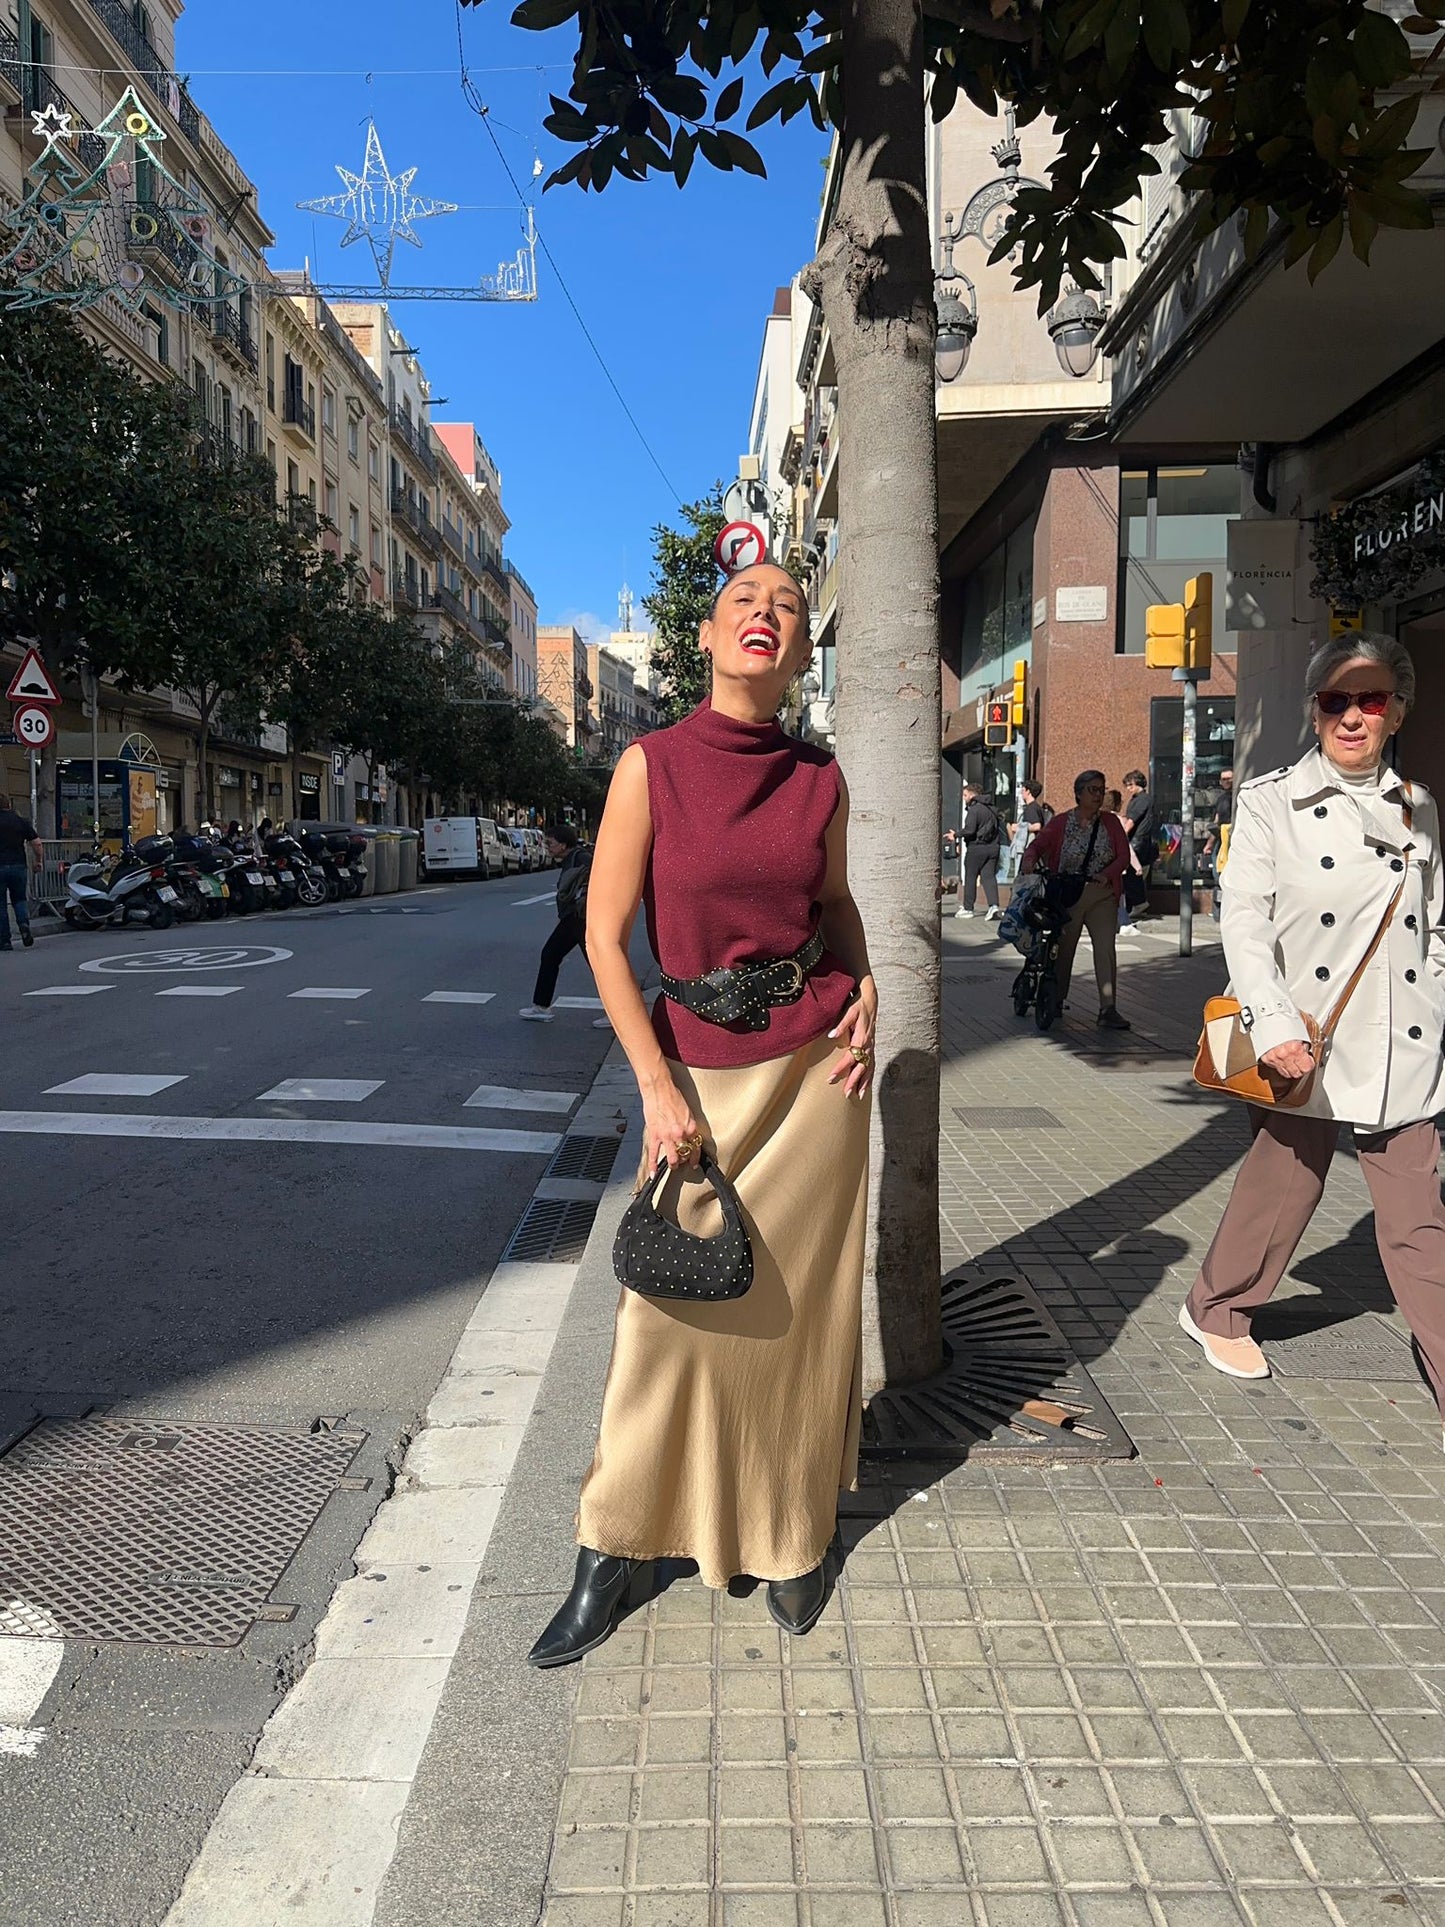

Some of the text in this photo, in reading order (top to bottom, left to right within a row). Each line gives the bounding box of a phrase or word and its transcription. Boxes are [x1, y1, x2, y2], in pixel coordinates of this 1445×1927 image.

[23, 718, 46, 734] 30
[335, 754, 342, 773] P
[124, 951, 249, 967] 30
